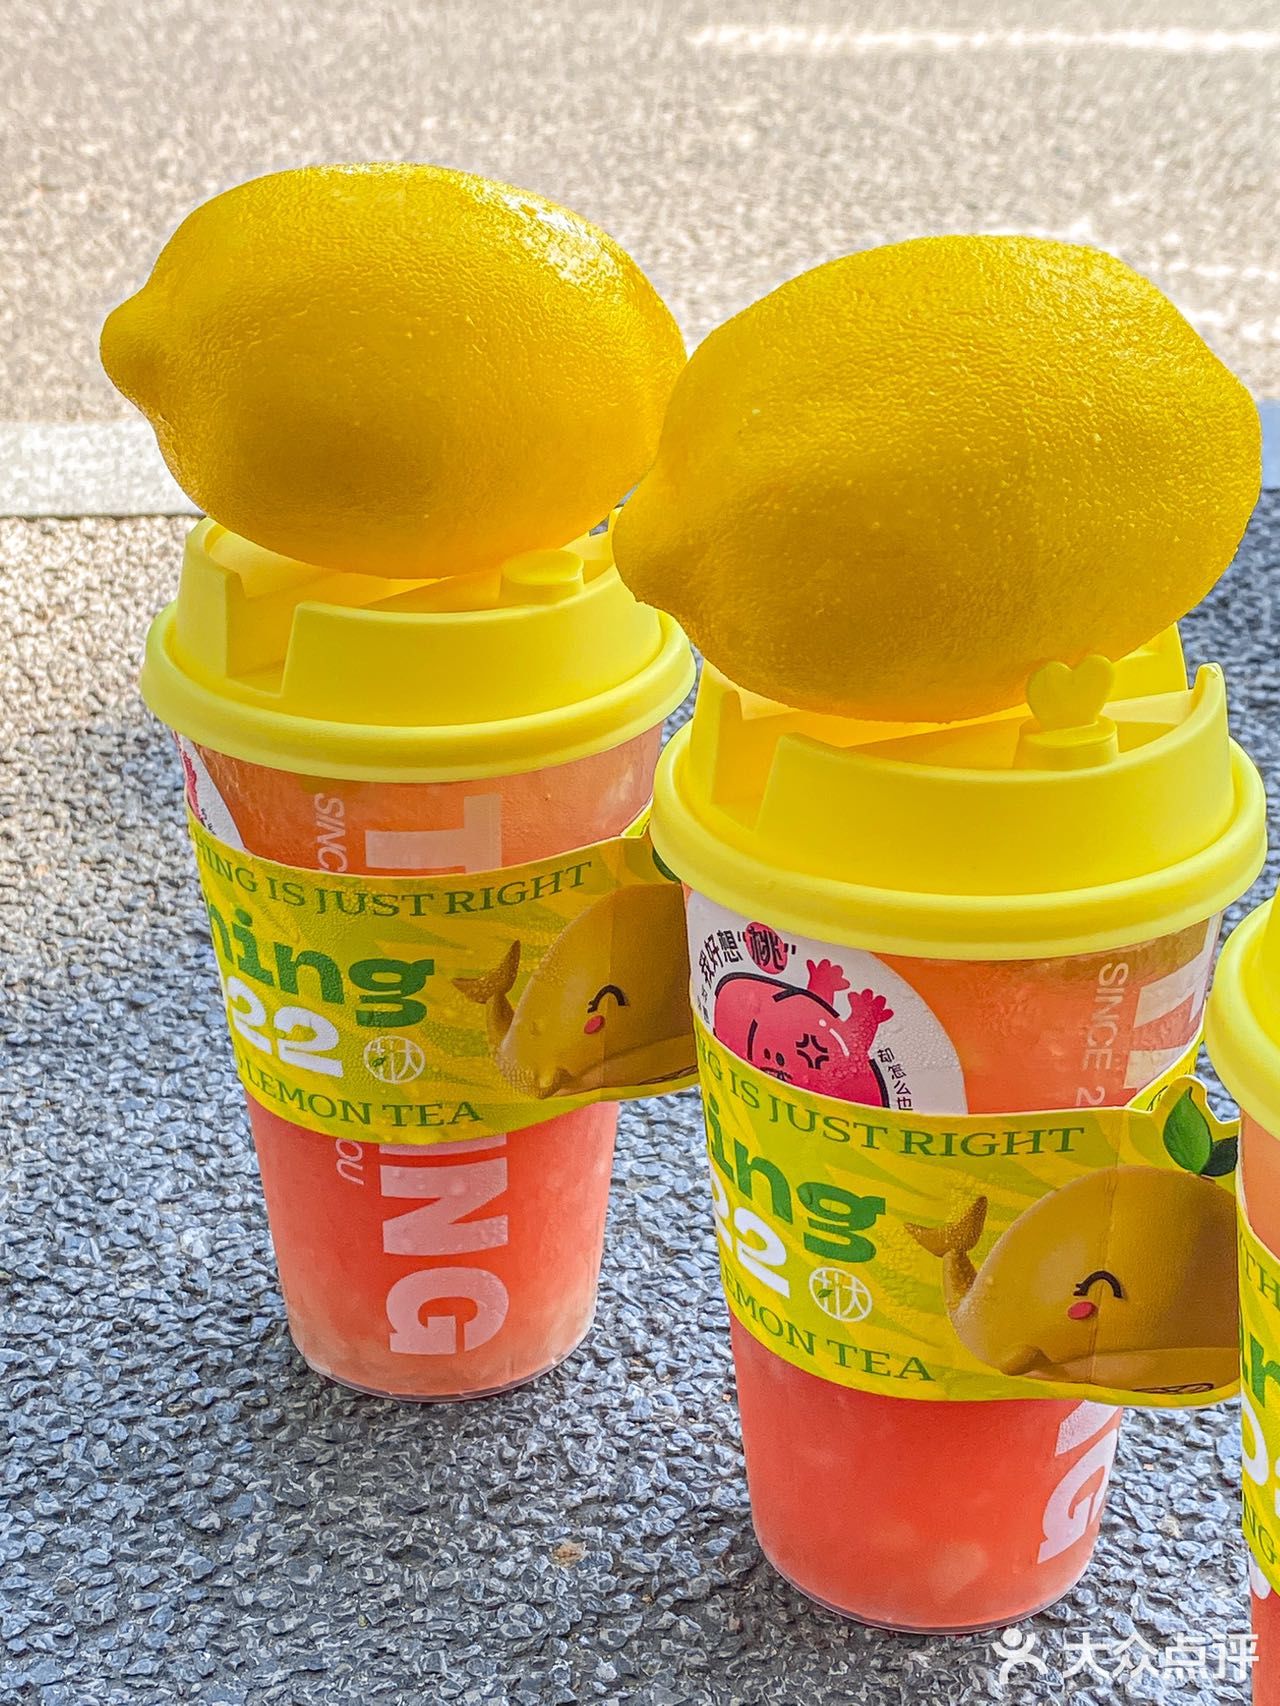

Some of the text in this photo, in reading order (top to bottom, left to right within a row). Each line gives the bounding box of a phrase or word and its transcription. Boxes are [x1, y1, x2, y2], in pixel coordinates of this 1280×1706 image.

[266, 876, 305, 907] IS
[312, 886, 433, 917] JUST
[446, 862, 593, 915] RIGHT
[225, 975, 345, 1079] 22
[1082, 962, 1129, 1071] SINCE
[246, 1057, 483, 1128] LEMON TEA
[728, 1068, 760, 1109] IS
[768, 1094, 888, 1150] JUST
[899, 1126, 1085, 1158] RIGHT
[722, 1262, 936, 1382] EMON TEA
